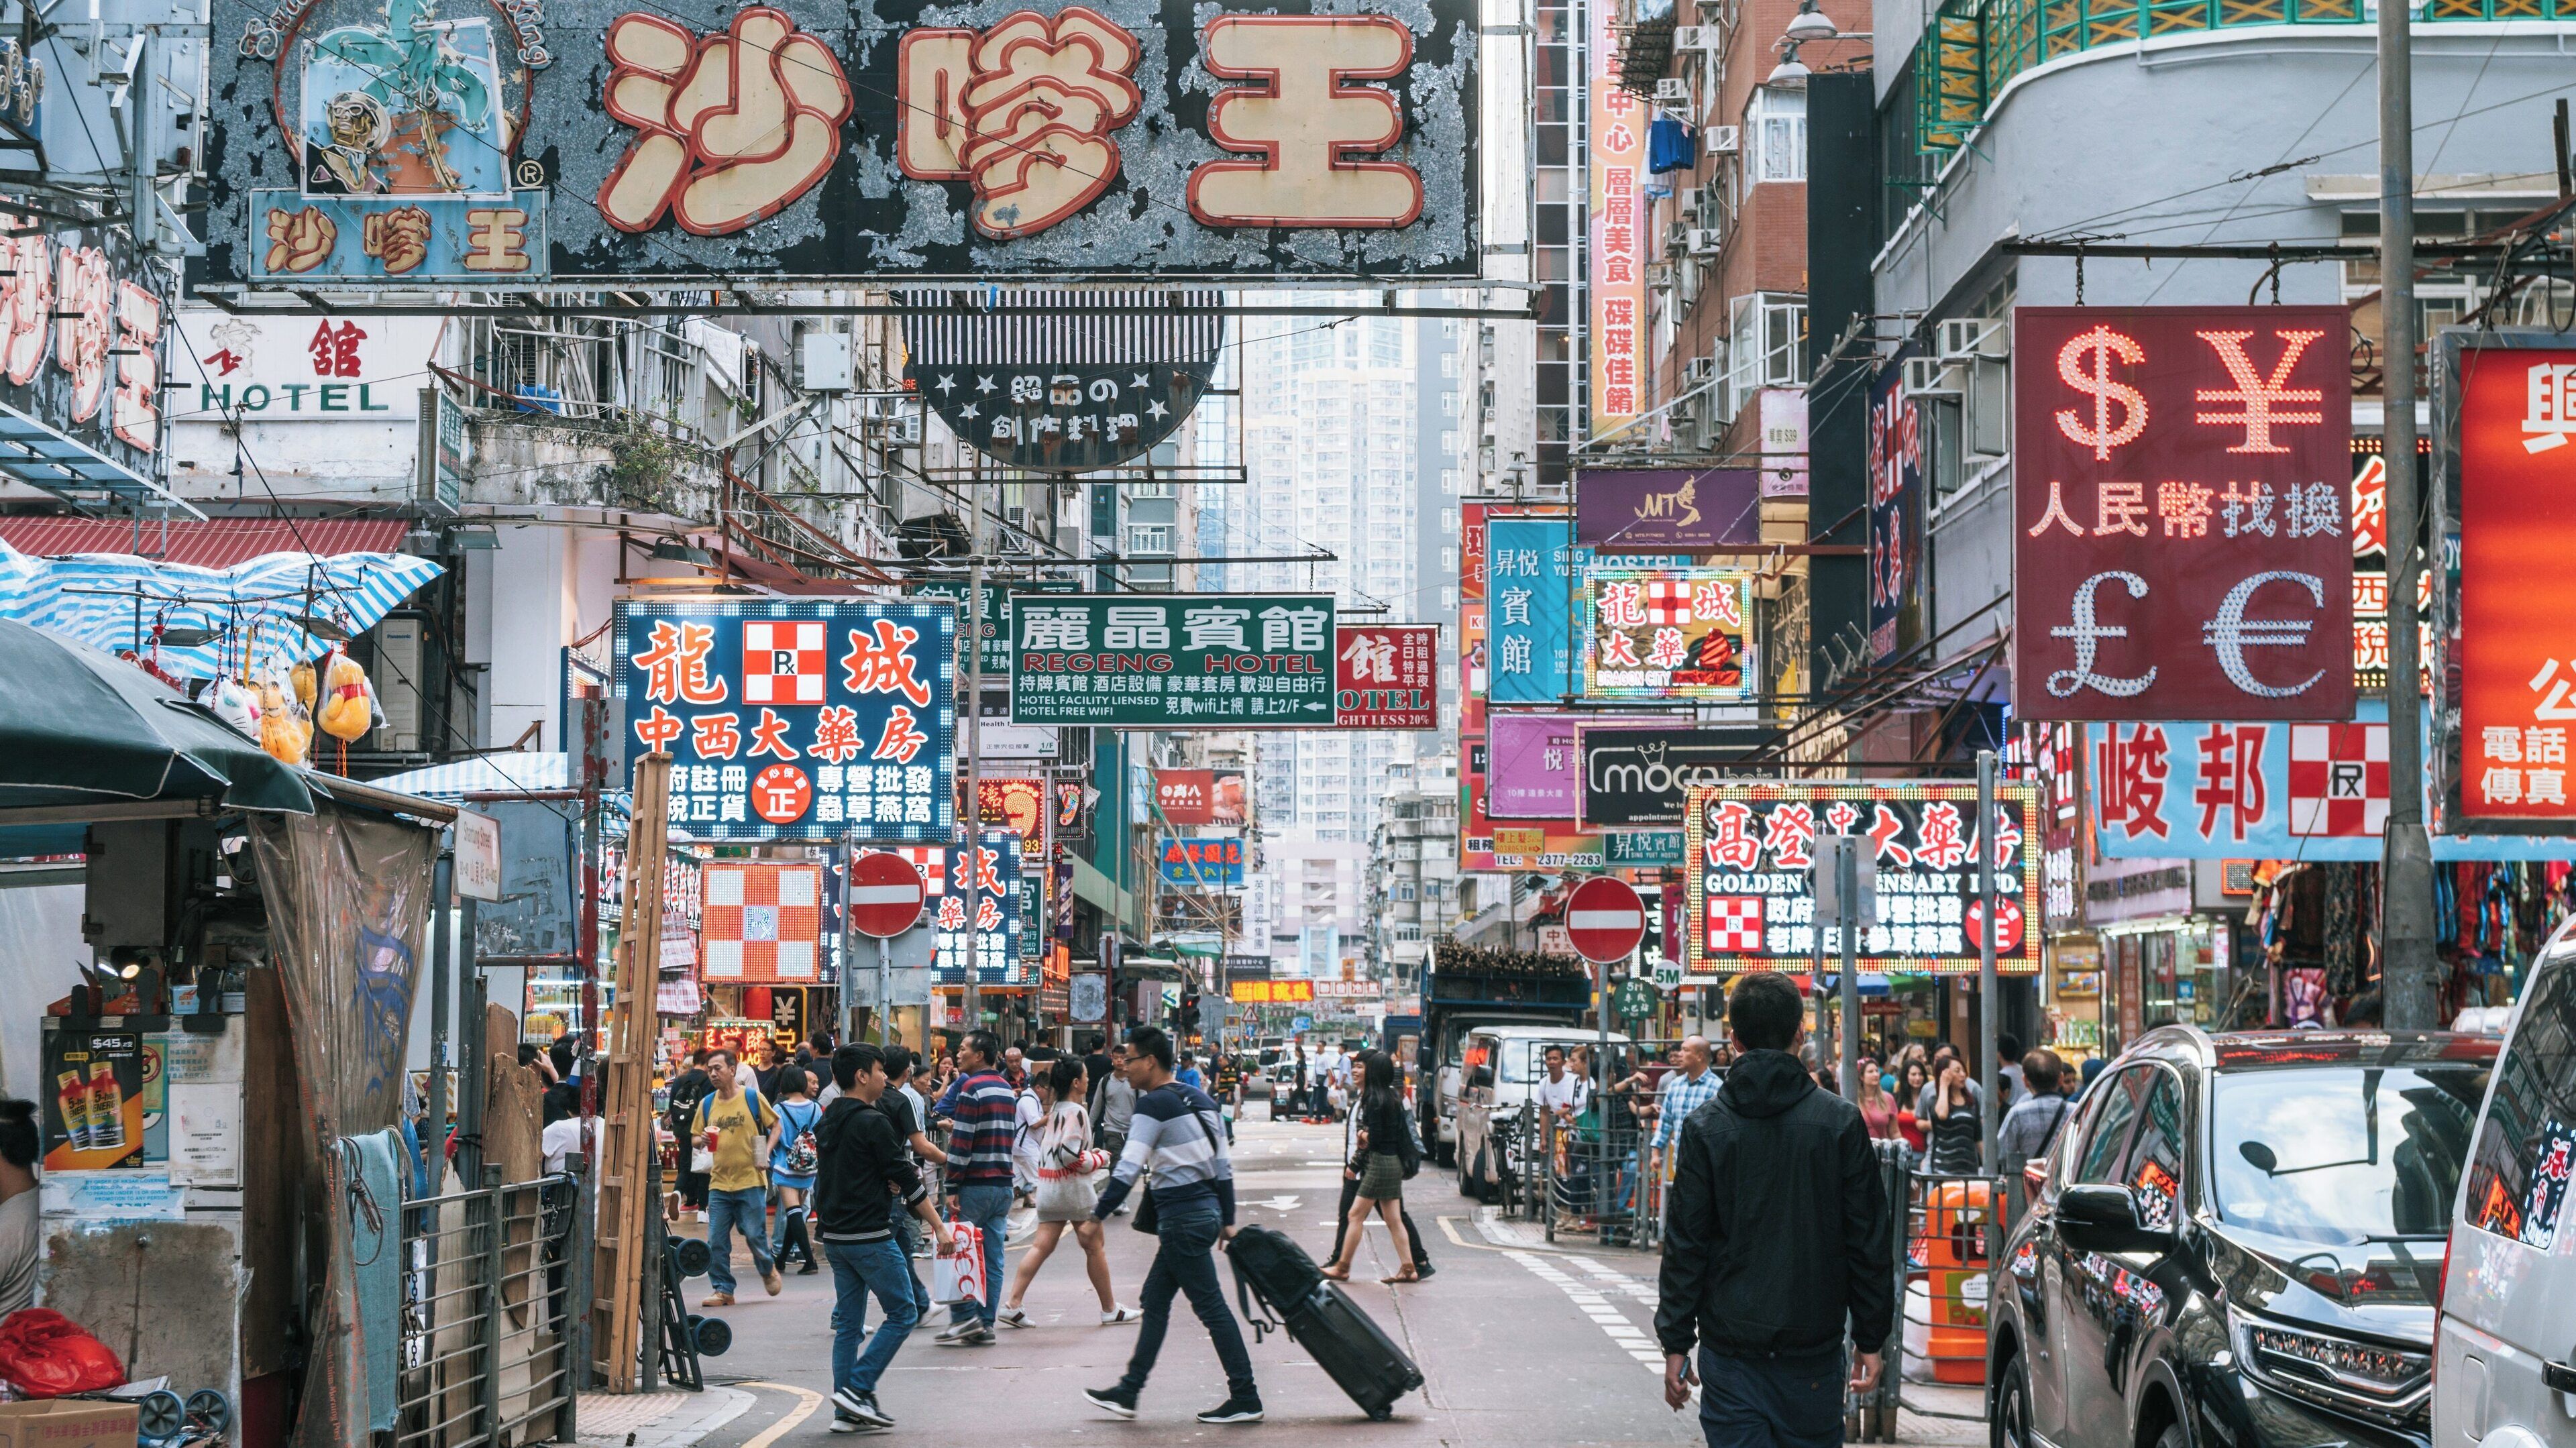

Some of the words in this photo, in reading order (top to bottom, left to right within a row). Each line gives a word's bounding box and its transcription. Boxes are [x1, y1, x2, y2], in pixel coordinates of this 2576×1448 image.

[1603, 166, 1635, 284] 層層美食
[201, 383, 390, 412] HOTEL
[2029, 481, 2344, 538] 人民幣找換
[1020, 605, 1328, 653] 麗晶賓館
[631, 619, 729, 705] 龍
[841, 618, 931, 708] 城
[1023, 654, 1174, 673] REGENG
[1205, 654, 1324, 674] HOTEL
[1417, 633, 1429, 687] 時租過夜
[1019, 675, 1087, 693] 持牌賓館
[1093, 675, 1162, 693] 酒店設備
[1167, 675, 1235, 693] 豪華套房
[1240, 675, 1327, 693] 歡迎自由行
[1596, 671, 1644, 686] DRAGON
[1646, 671, 1672, 686] CITY
[1019, 695, 1057, 706] HOTEL
[1059, 695, 1109, 706] FACILITY
[1112, 695, 1159, 706] LIENSED
[1166, 697, 1244, 715] 免費wifi上網
[1337, 689, 1430, 711] OTEL
[1019, 706, 1057, 716] HOTEL
[1059, 706, 1089, 716] FREE
[1092, 706, 1114, 716] WIFI
[1339, 715, 1368, 726] GHT
[1372, 715, 1406, 726] LESS
[1409, 715, 1430, 726] 20%
[635, 705, 929, 765] 中西大藥房
[2481, 726, 2567, 765] 電話
[816, 765, 933, 794] 專營批發
[2480, 767, 2567, 806] 傳真
[765, 788, 797, 817] 正
[816, 794, 933, 823] 蟲草燕窩
[1629, 814, 1682, 822] appointment
[1024, 840, 1039, 851] 93
[1496, 855, 1522, 865] TEL:
[1538, 854, 1601, 865] 2377-2263
[1706, 874, 1801, 893] GOLDEN
[1876, 874, 1962, 893] ENSARY
[1656, 969, 1679, 984] 5M
[93, 1038, 121, 1049] $45
[739, 1052, 761, 1066] LAO
